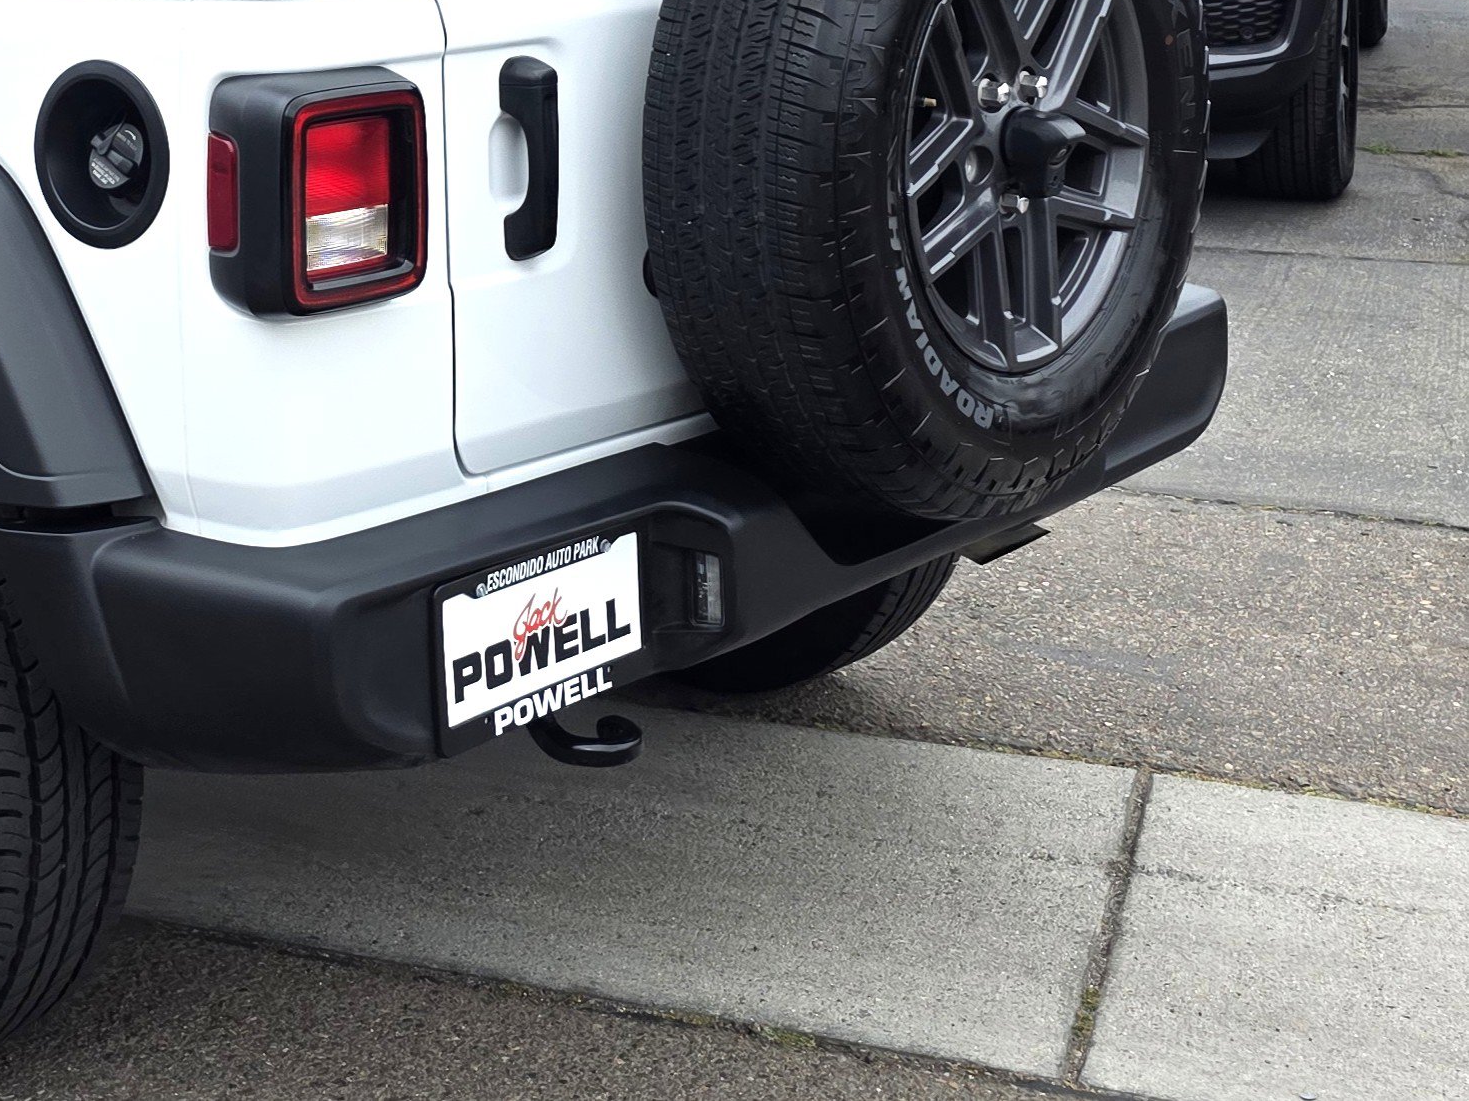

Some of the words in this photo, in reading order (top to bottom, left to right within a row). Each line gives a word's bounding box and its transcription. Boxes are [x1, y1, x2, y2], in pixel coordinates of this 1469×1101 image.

[895, 266, 995, 430] ROADIAN
[487, 555, 545, 592] ESCONDIDO
[544, 545, 573, 571] AUTO
[573, 535, 601, 561] PARK
[452, 598, 632, 705] POWELL
[513, 587, 568, 661] Jack
[493, 667, 614, 736] POWELL
